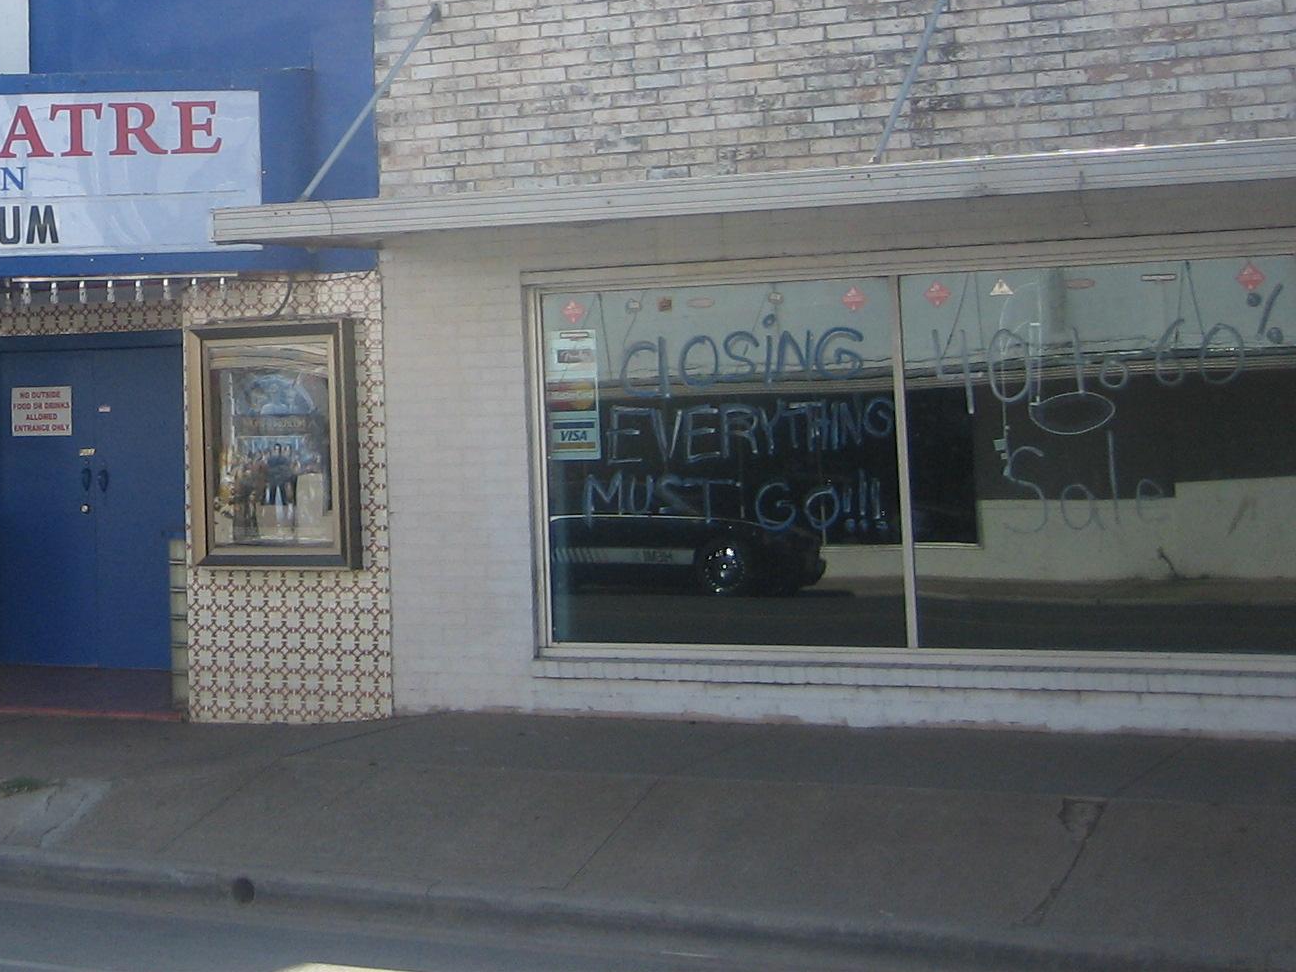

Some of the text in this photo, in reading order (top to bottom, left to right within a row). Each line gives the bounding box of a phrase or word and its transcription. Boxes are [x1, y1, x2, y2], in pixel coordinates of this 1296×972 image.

[932, 327, 1033, 415] 40
[20, 391, 61, 399] NO OUTSIDE
[33, 402, 43, 410] OR
[26, 413, 58, 421] ALLOWED
[14, 424, 70, 432] ENTRANCE ONLY
[606, 396, 895, 465] EVERYTHING
[560, 430, 588, 442] VISA
[1004, 430, 1171, 534] Sale
[582, 472, 743, 528] MUST
